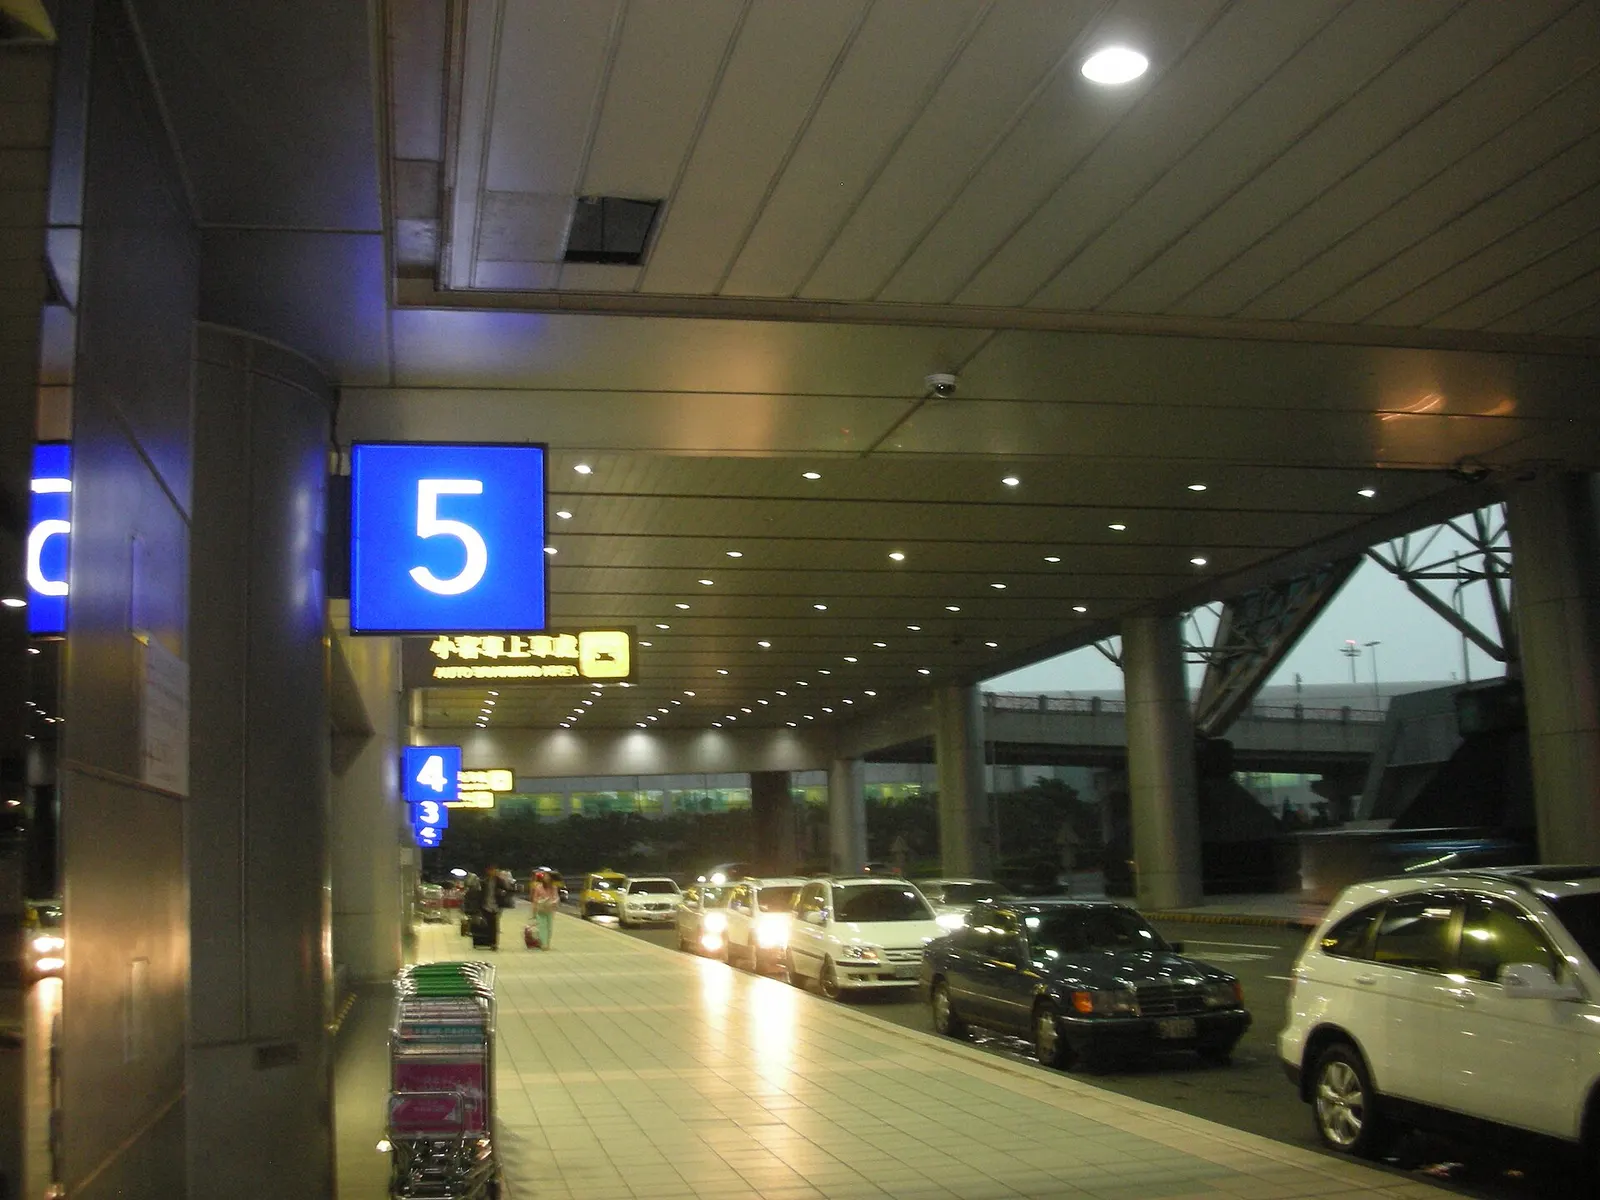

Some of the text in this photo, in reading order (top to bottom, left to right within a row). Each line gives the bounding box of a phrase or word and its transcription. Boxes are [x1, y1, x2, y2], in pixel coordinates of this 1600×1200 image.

[408, 478, 488, 596] 5
[416, 755, 448, 792] 4
[420, 800, 440, 824] 3
